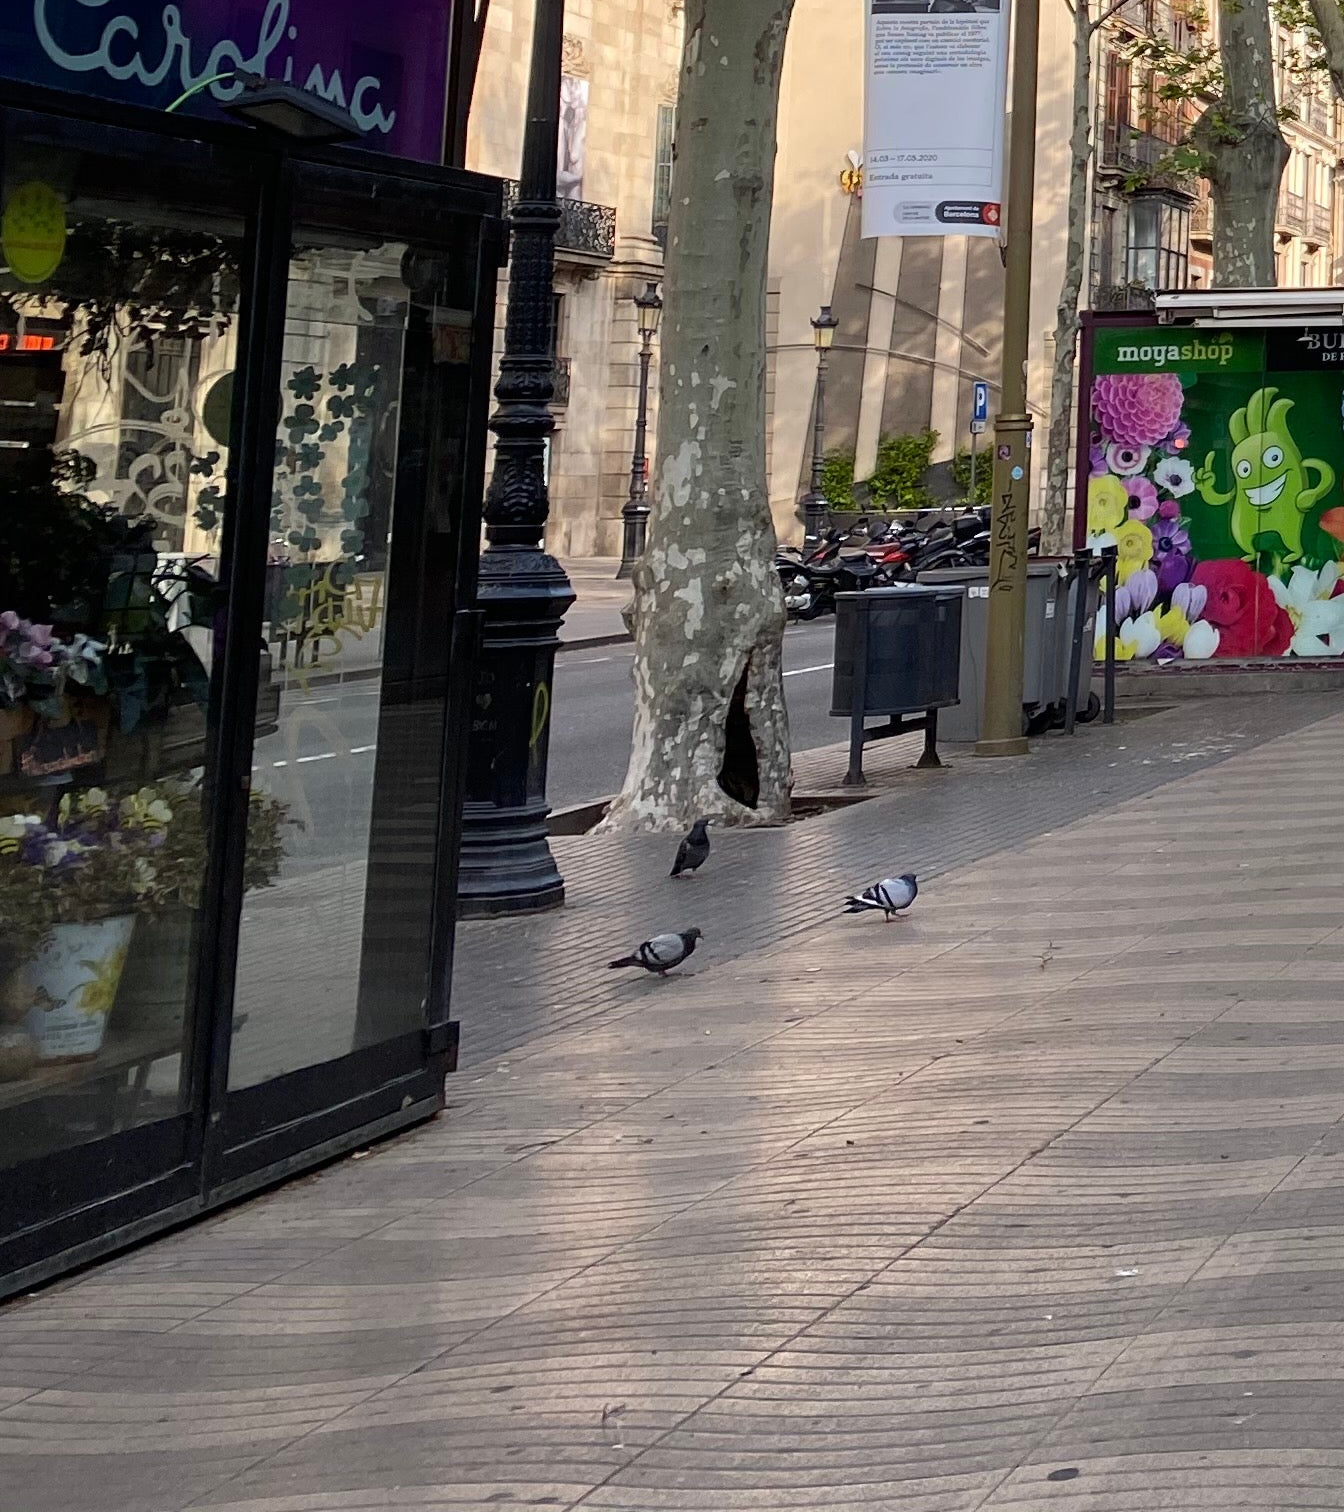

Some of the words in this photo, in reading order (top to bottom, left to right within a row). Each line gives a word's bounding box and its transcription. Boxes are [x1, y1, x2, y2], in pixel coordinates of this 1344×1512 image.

[869, 173, 899, 181] Entrada
[1117, 340, 1233, 367] moyashop
[1322, 352, 1338, 362] DE
